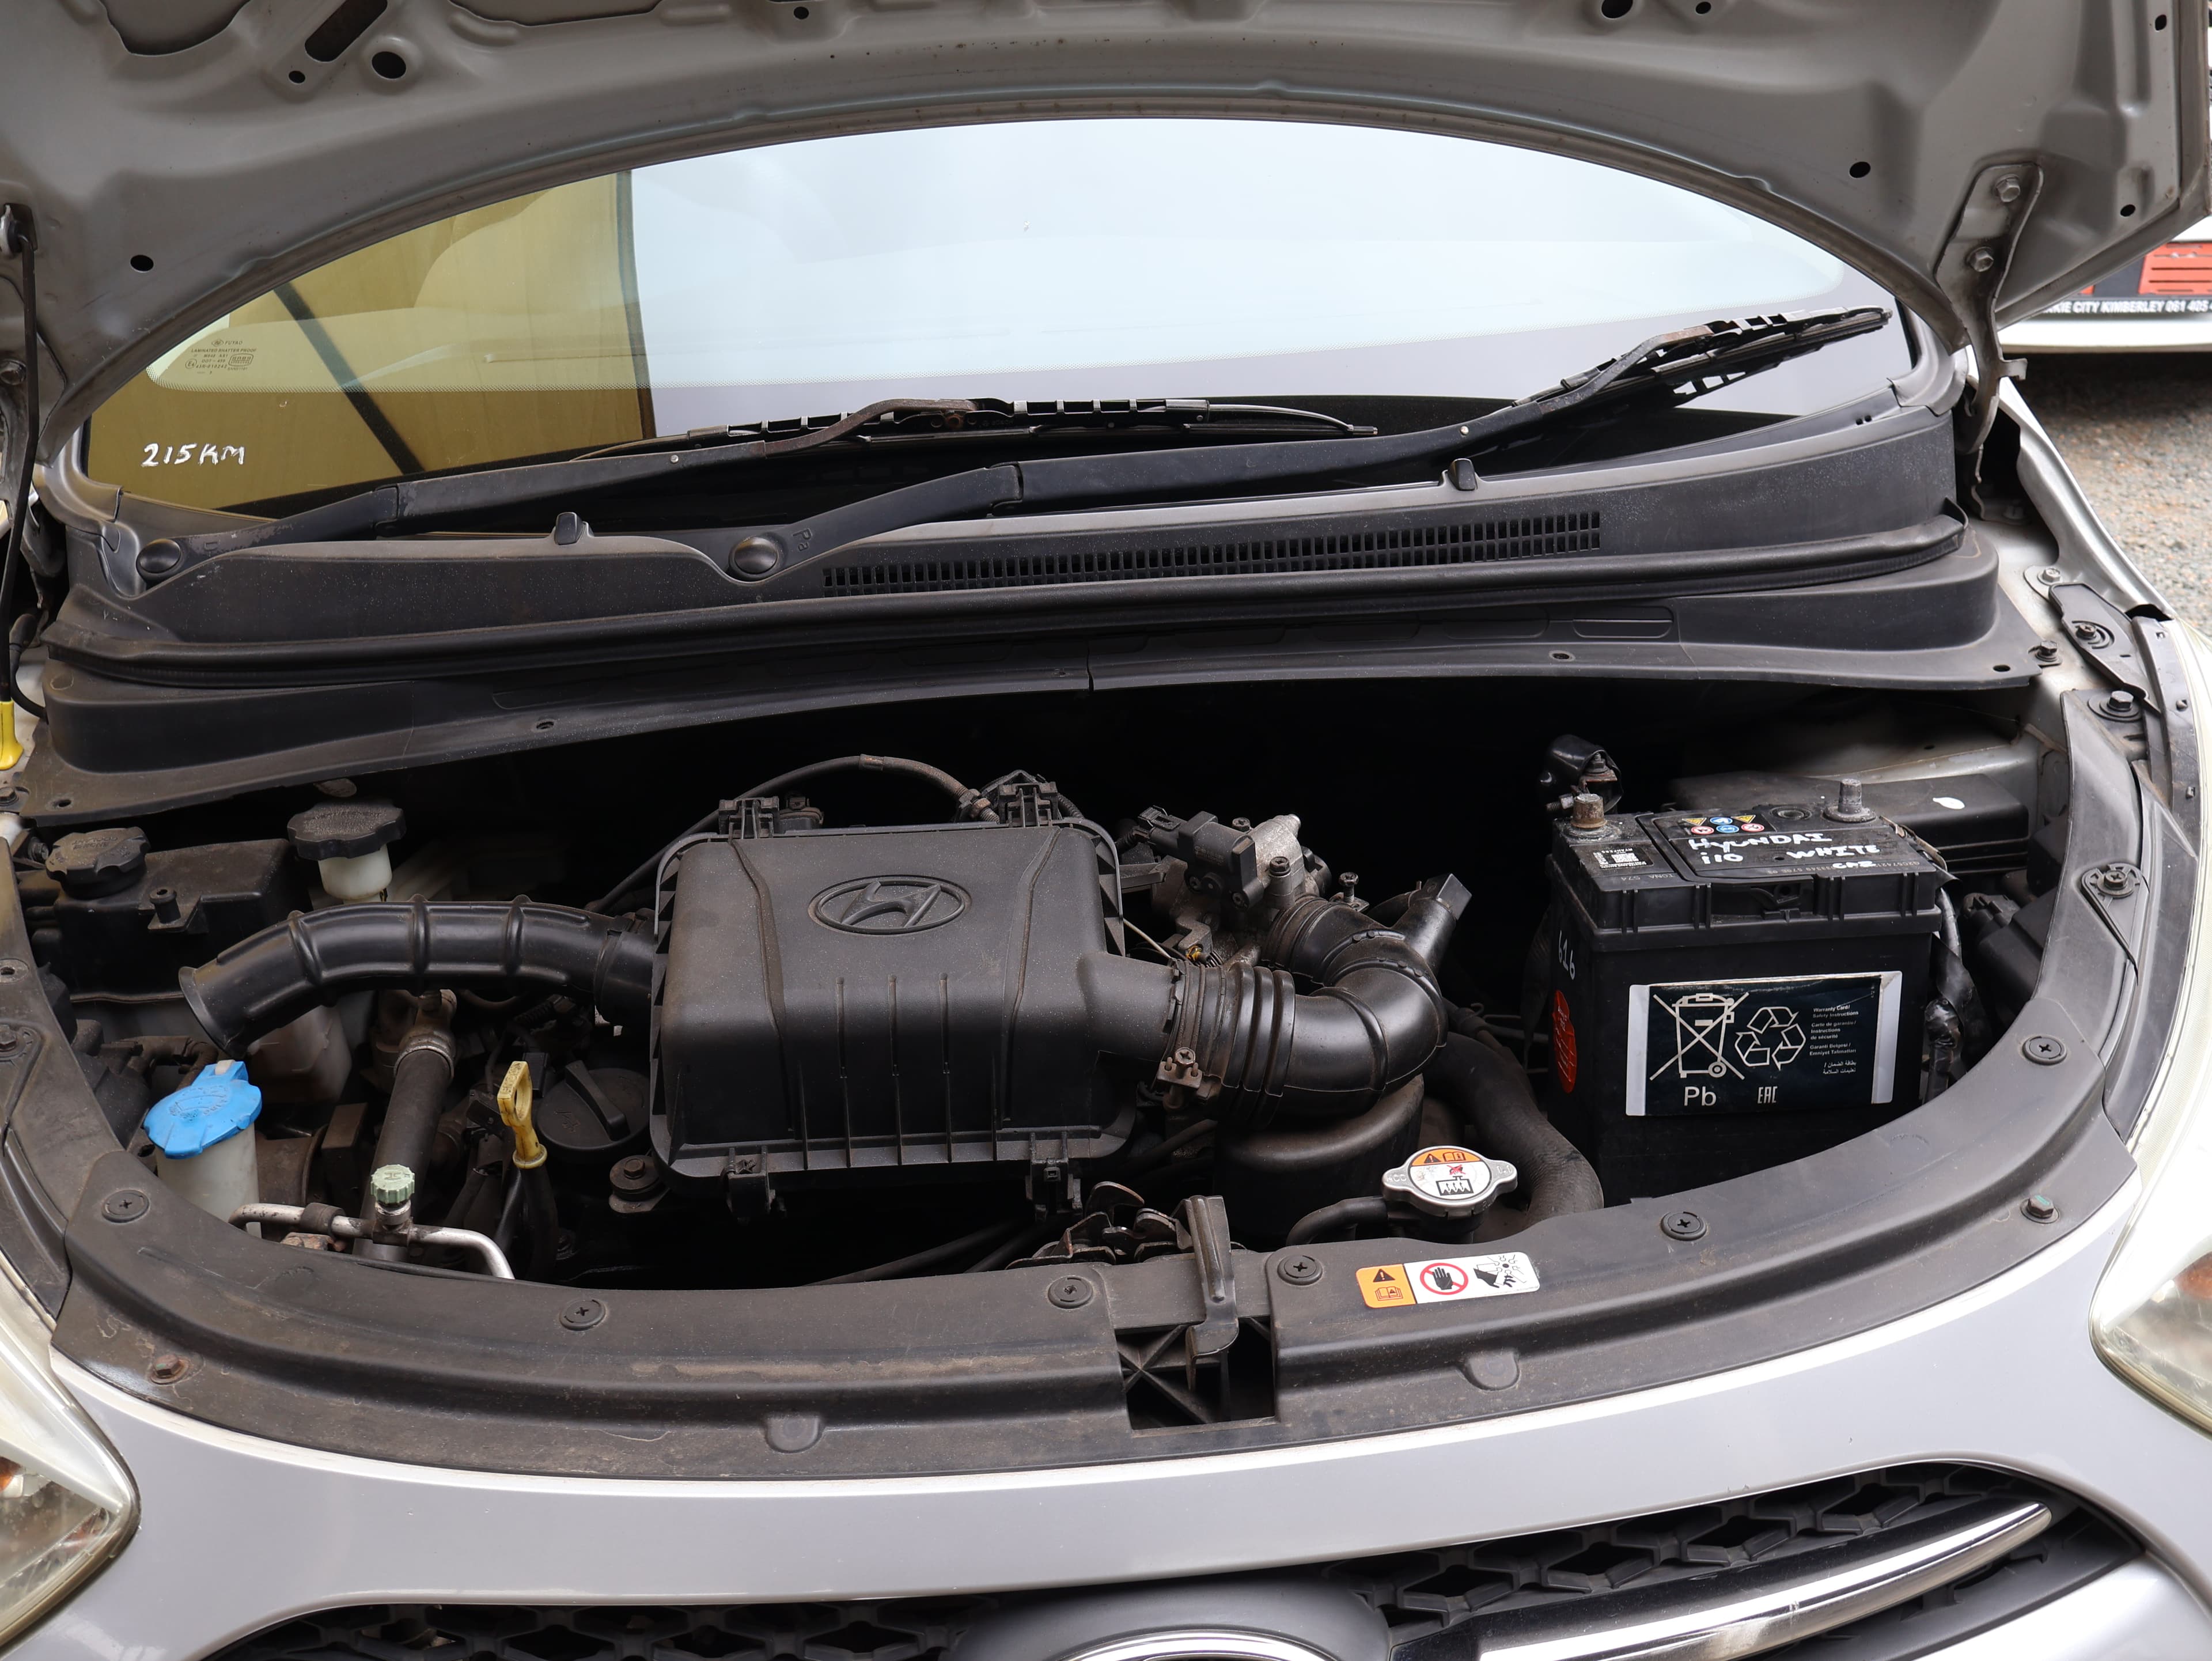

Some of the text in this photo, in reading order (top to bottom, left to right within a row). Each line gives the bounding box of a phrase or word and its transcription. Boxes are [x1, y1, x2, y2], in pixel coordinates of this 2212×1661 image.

[2073, 301, 2101, 313] CITY
[2101, 300, 2165, 313] KIMBERLEY
[2165, 300, 2187, 313] 061
[1786, 845, 1880, 858] WHITE
[1684, 1086, 1778, 1106] Pb EAC
